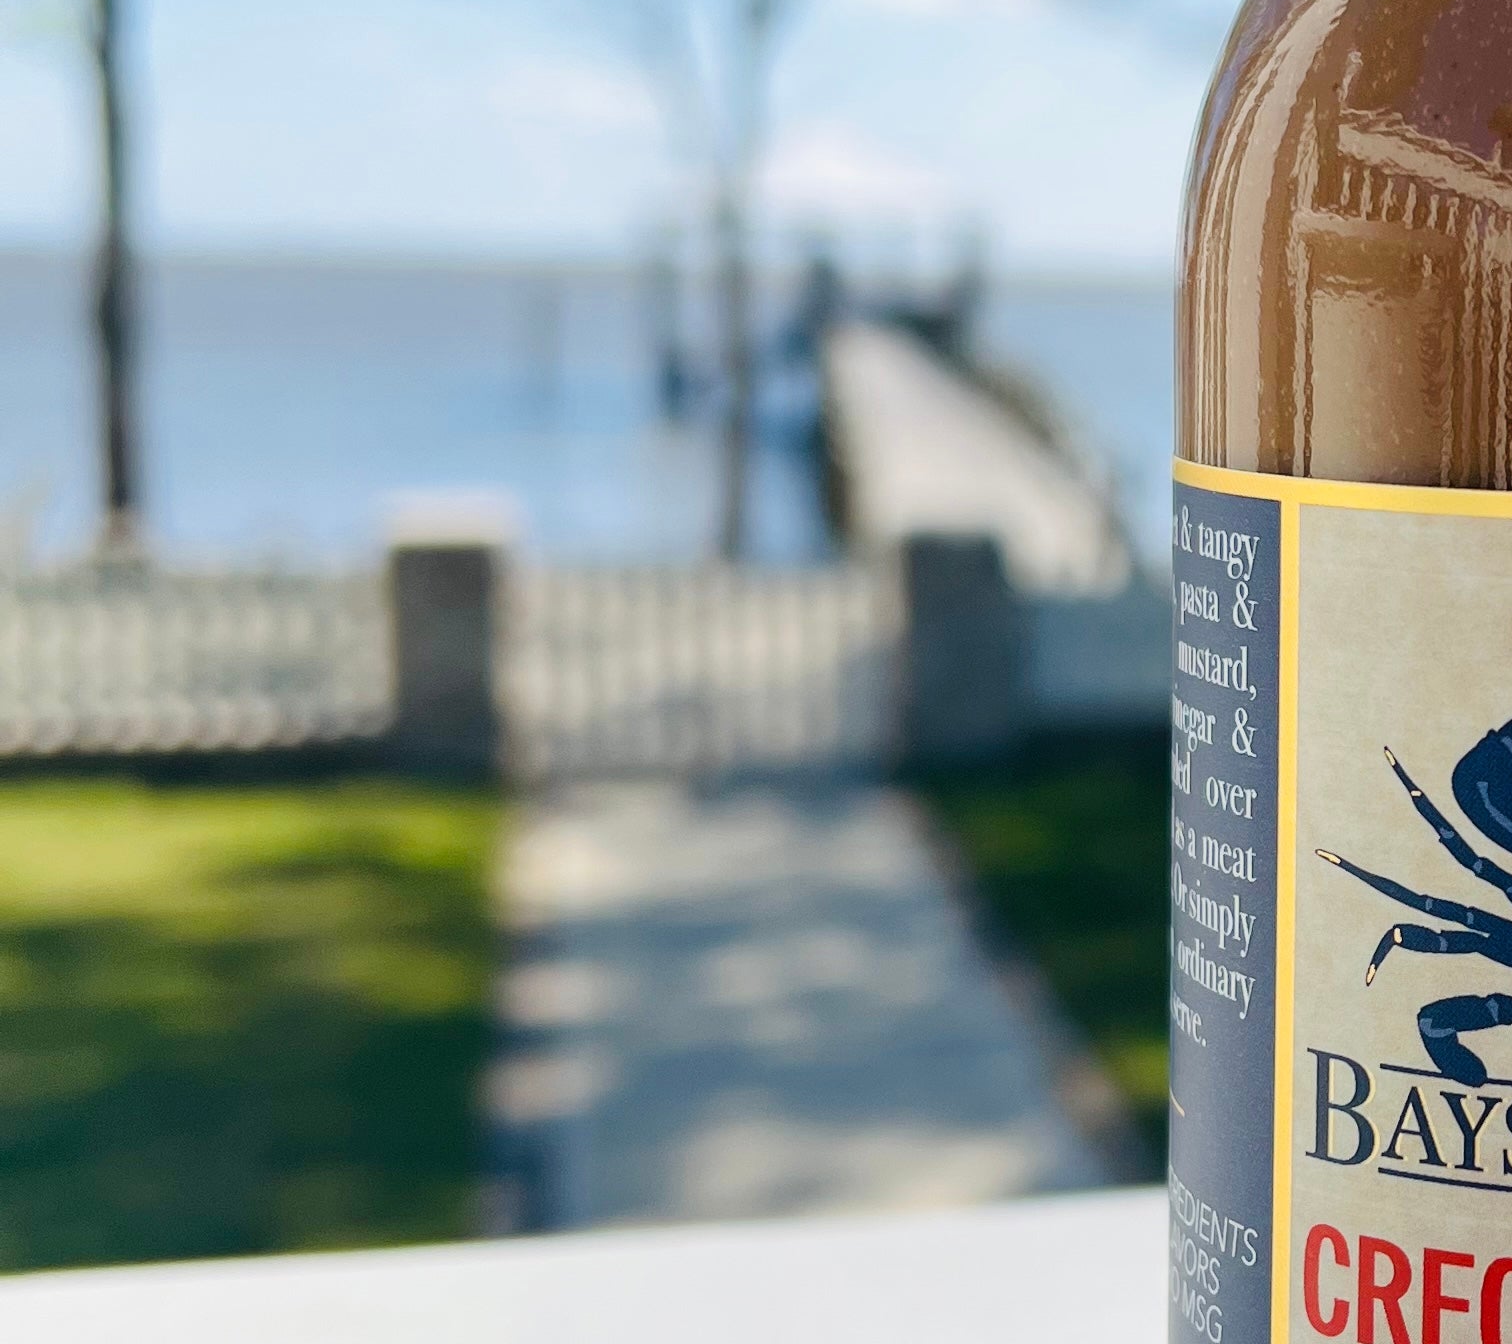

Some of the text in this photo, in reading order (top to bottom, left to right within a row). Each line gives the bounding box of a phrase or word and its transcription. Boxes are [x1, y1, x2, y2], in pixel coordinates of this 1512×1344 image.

[1181, 504, 1193, 554] &
[1198, 521, 1260, 582] tangy
[1180, 580, 1260, 632] pasta &
[1177, 639, 1257, 701] mustard,
[1231, 706, 1259, 758] &
[1206, 776, 1258, 820] over
[1187, 827, 1197, 860] a
[1201, 835, 1257, 883] meat
[1173, 860, 1257, 958] Or simply
[1177, 937, 1257, 1020] ordinary
[1182, 1279, 1223, 1344] MSG
